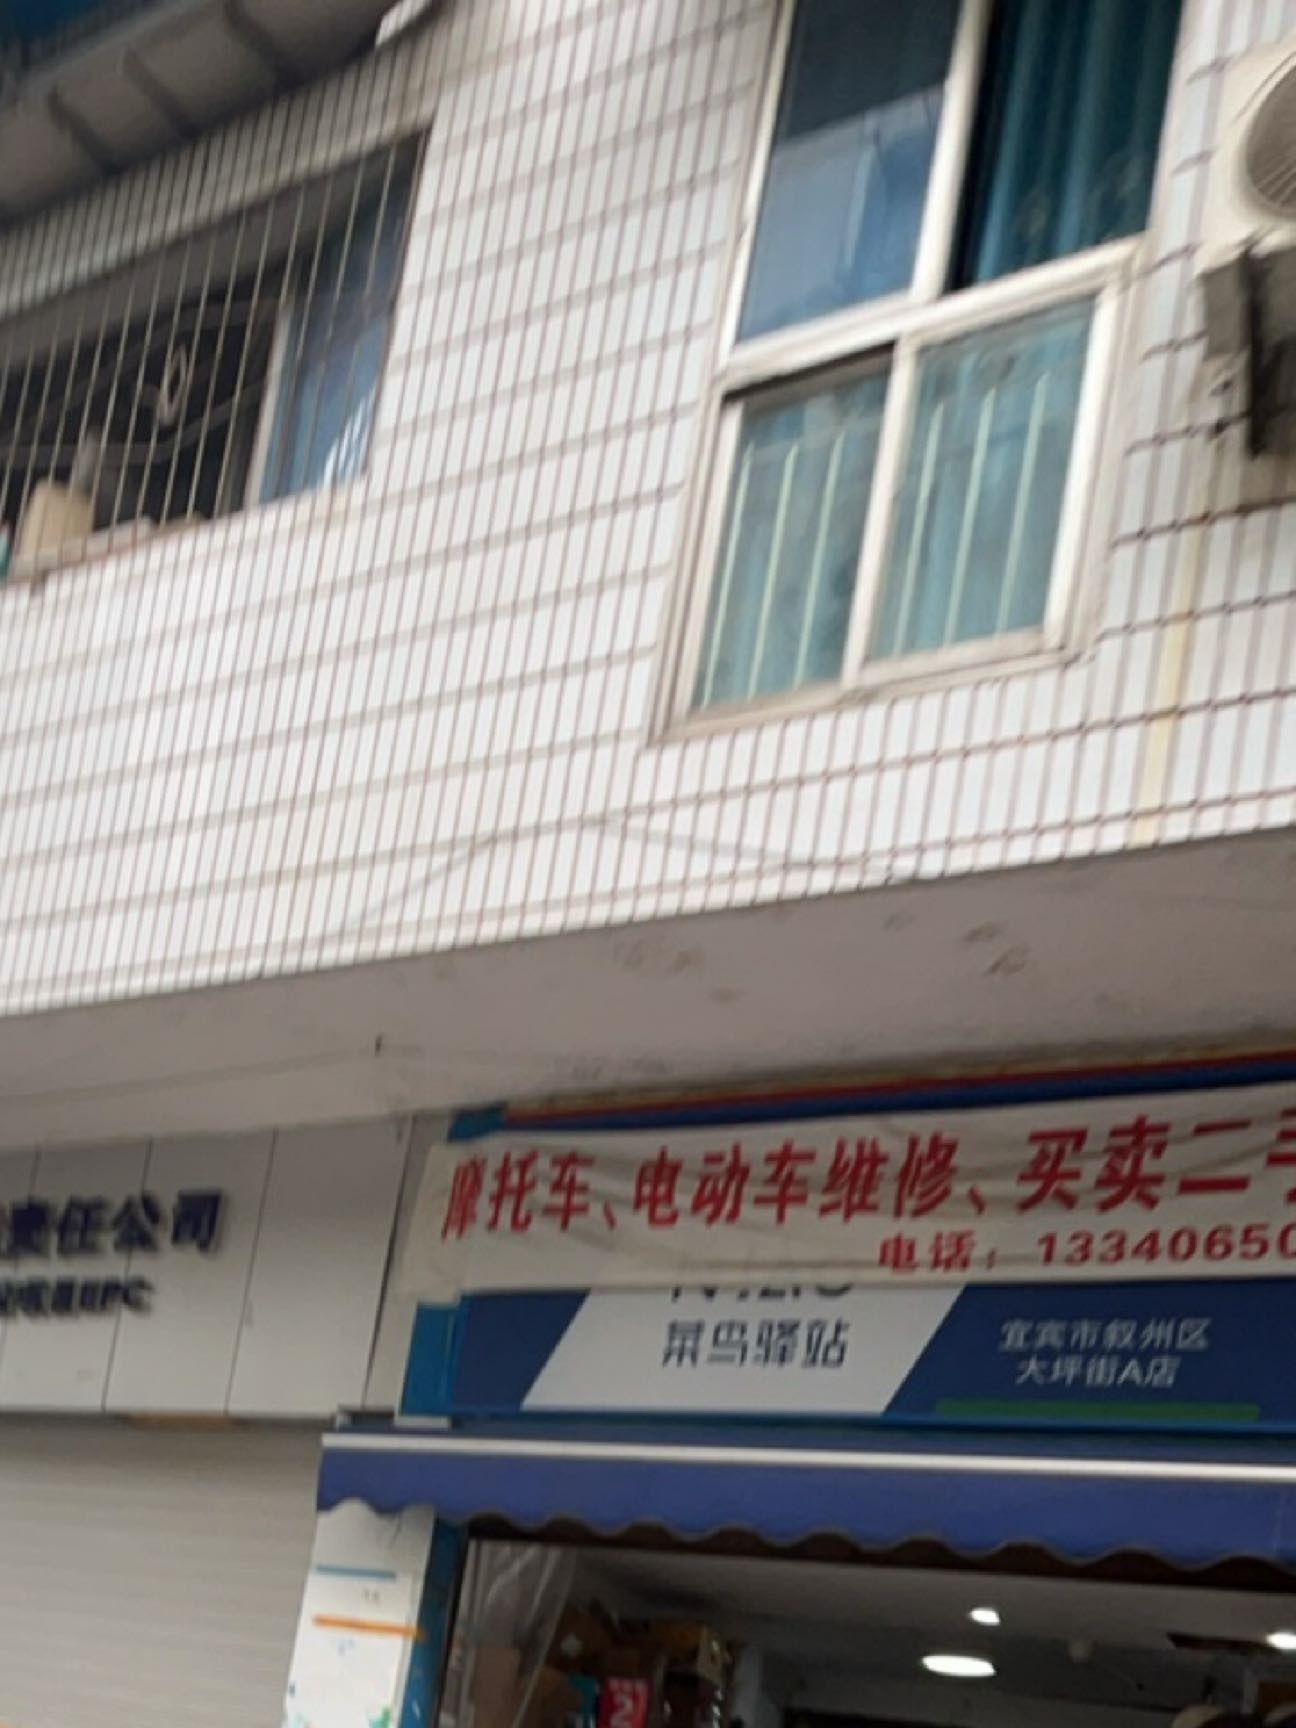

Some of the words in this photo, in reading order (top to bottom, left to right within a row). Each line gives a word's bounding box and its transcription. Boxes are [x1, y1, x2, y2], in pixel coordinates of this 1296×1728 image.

[662, 1317, 851, 1369] 菜鸟驿站
[998, 1317, 1213, 1351] 宜宾市叙州区
[1014, 1353, 1182, 1388] 大坪街A店
